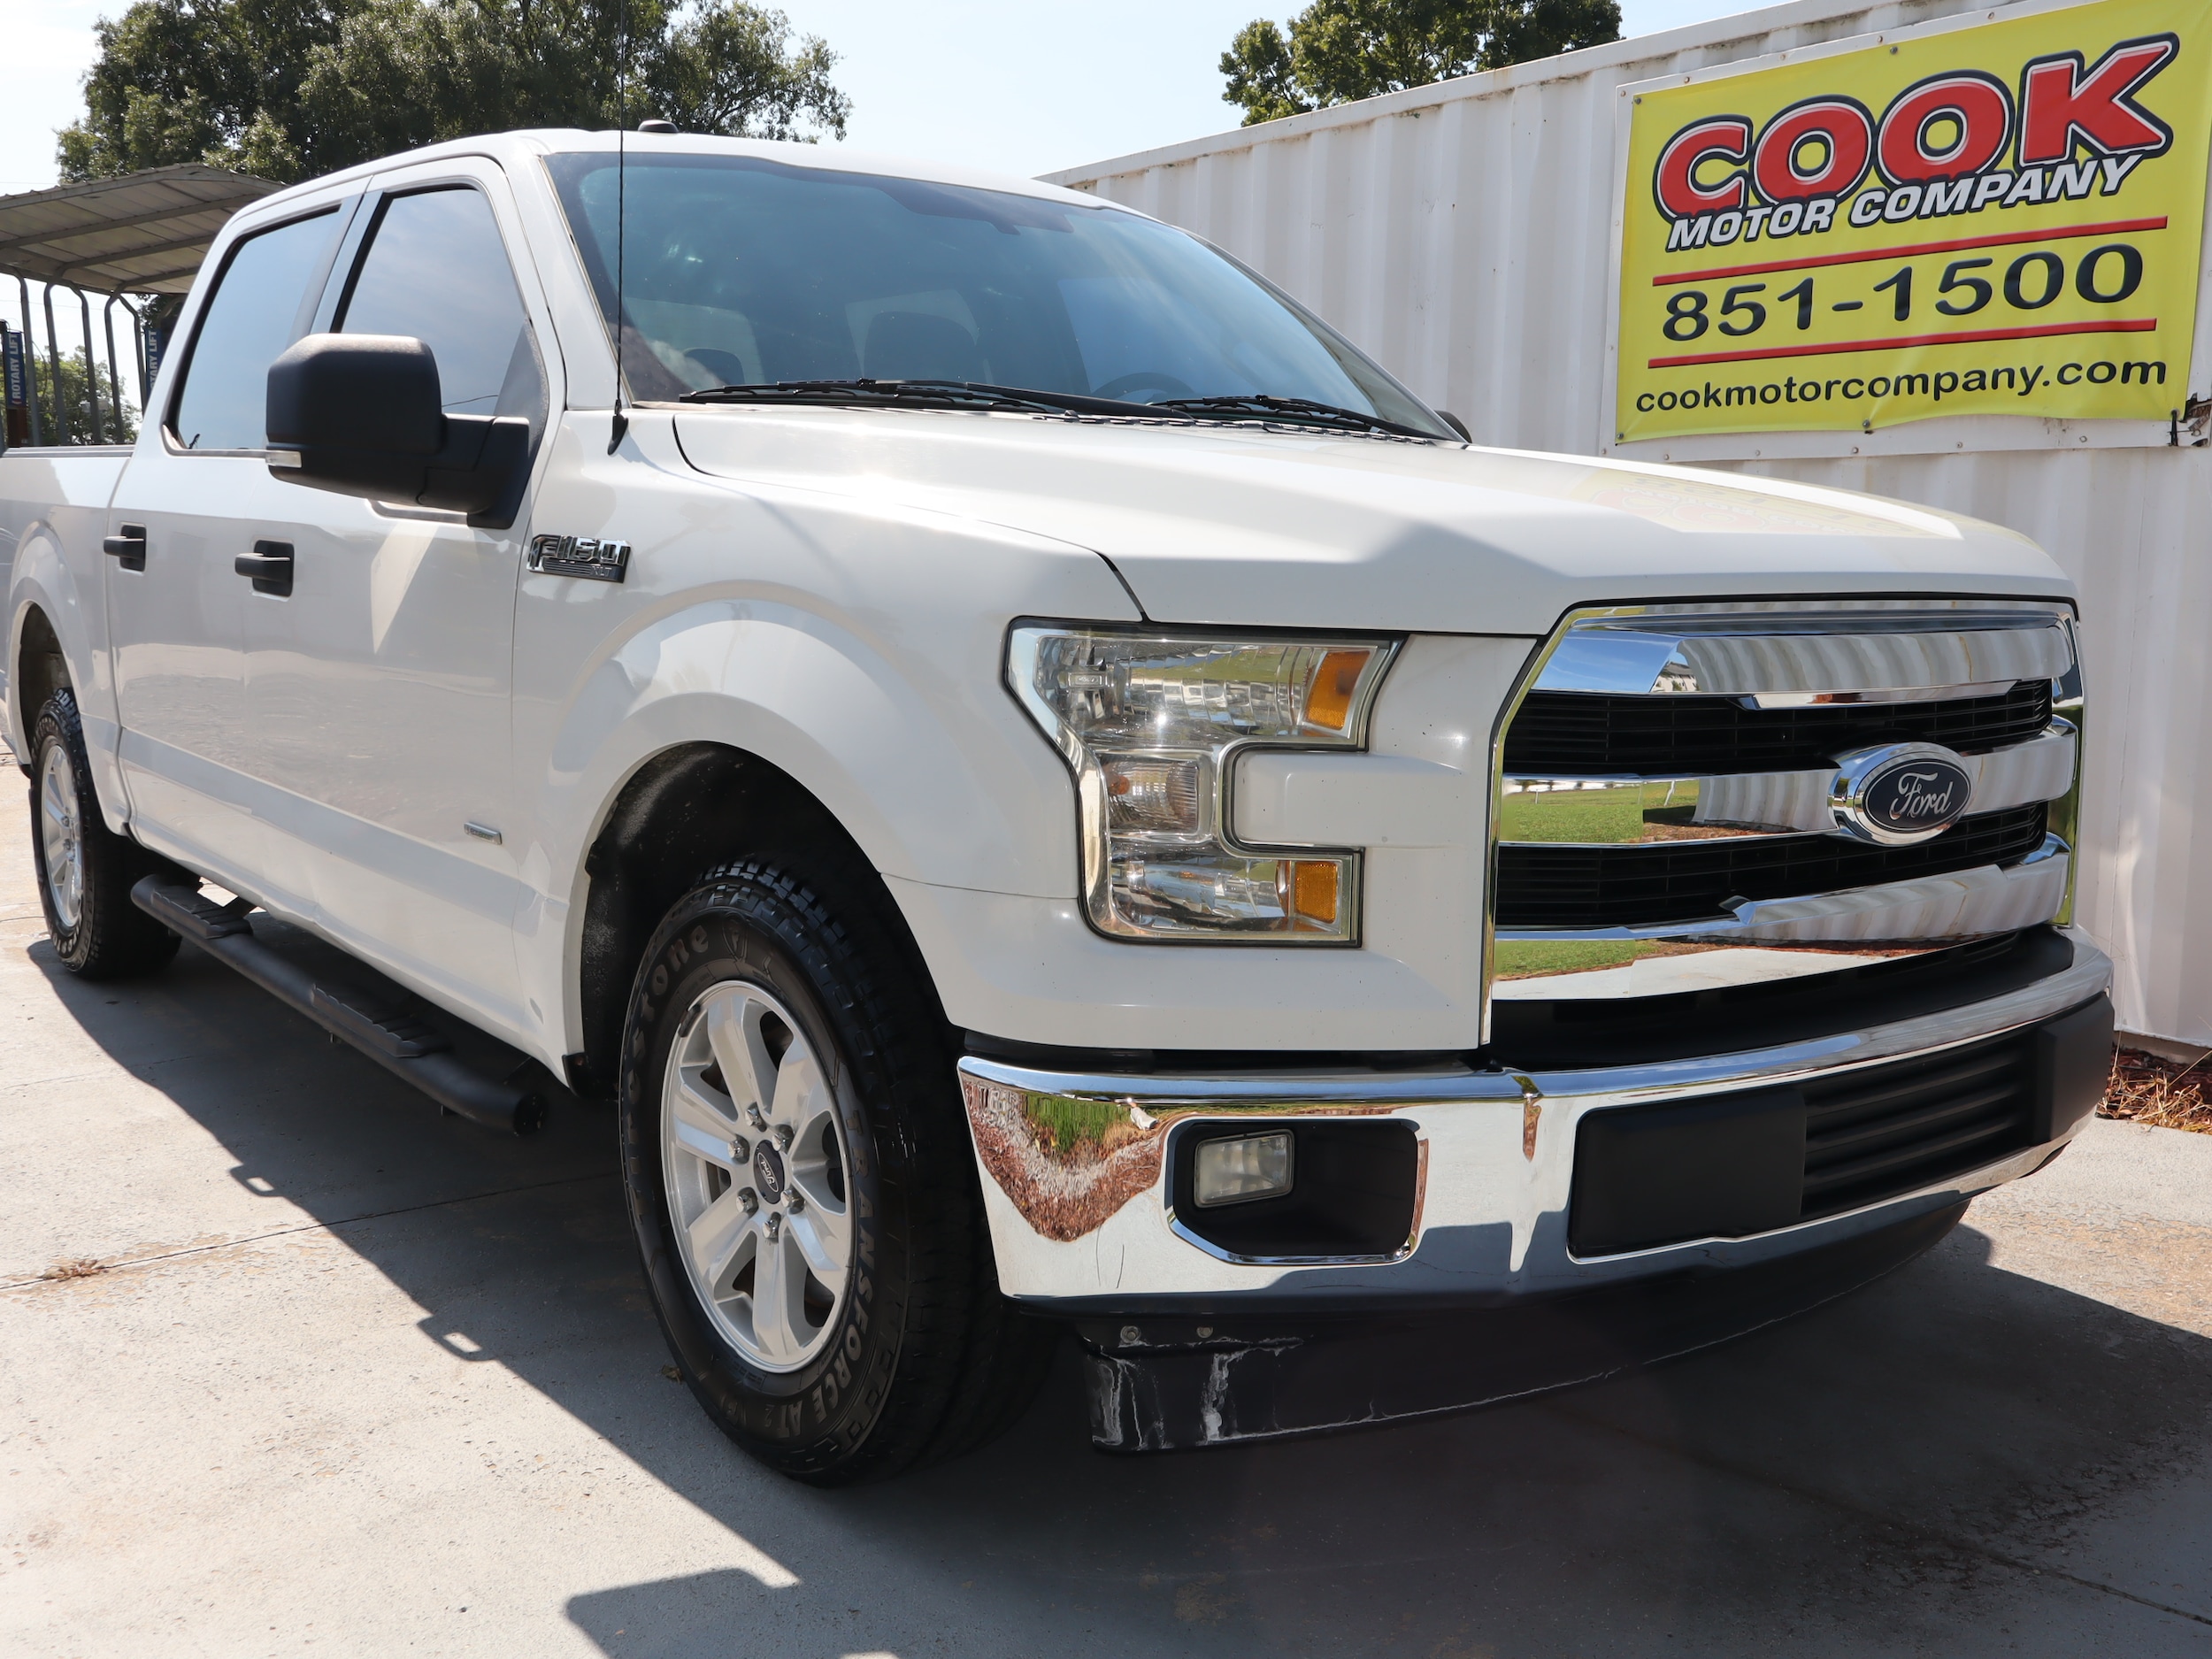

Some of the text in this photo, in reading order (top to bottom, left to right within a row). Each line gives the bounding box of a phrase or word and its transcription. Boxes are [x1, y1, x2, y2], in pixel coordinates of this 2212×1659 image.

[1654, 33, 2178, 223] COOK
[1667, 154, 2142, 250] MOTOR COMPANY
[1663, 242, 2143, 342] 851-1500
[9, 333, 21, 399] ROTARY LIFT
[148, 330, 157, 352] LIFT
[1636, 359, 2167, 413] cookmotorcompany.com
[1889, 772, 1954, 820] Ford
